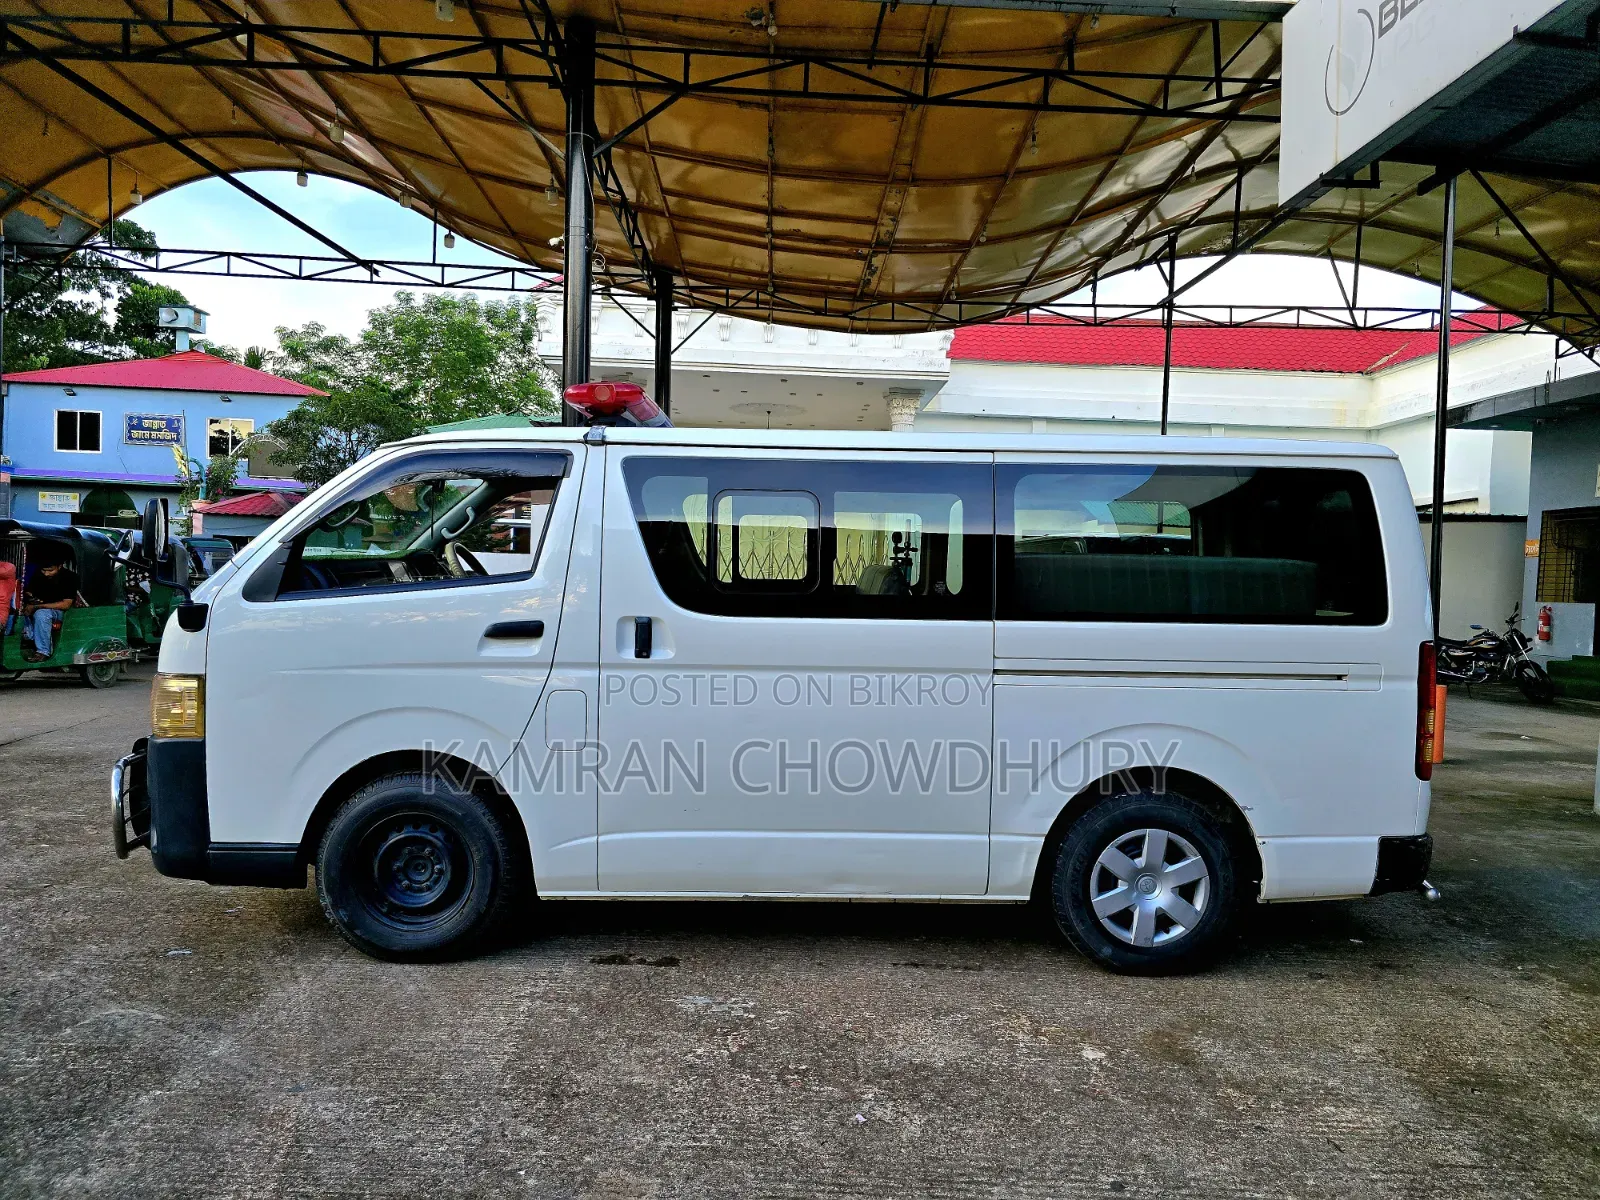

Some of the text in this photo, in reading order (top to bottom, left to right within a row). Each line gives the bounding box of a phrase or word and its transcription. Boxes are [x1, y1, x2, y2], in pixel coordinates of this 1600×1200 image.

[1378, 0, 1424, 39] BE
[142, 419, 167, 430] জান্নাত
[131, 428, 178, 441] জামে মসজিদ
